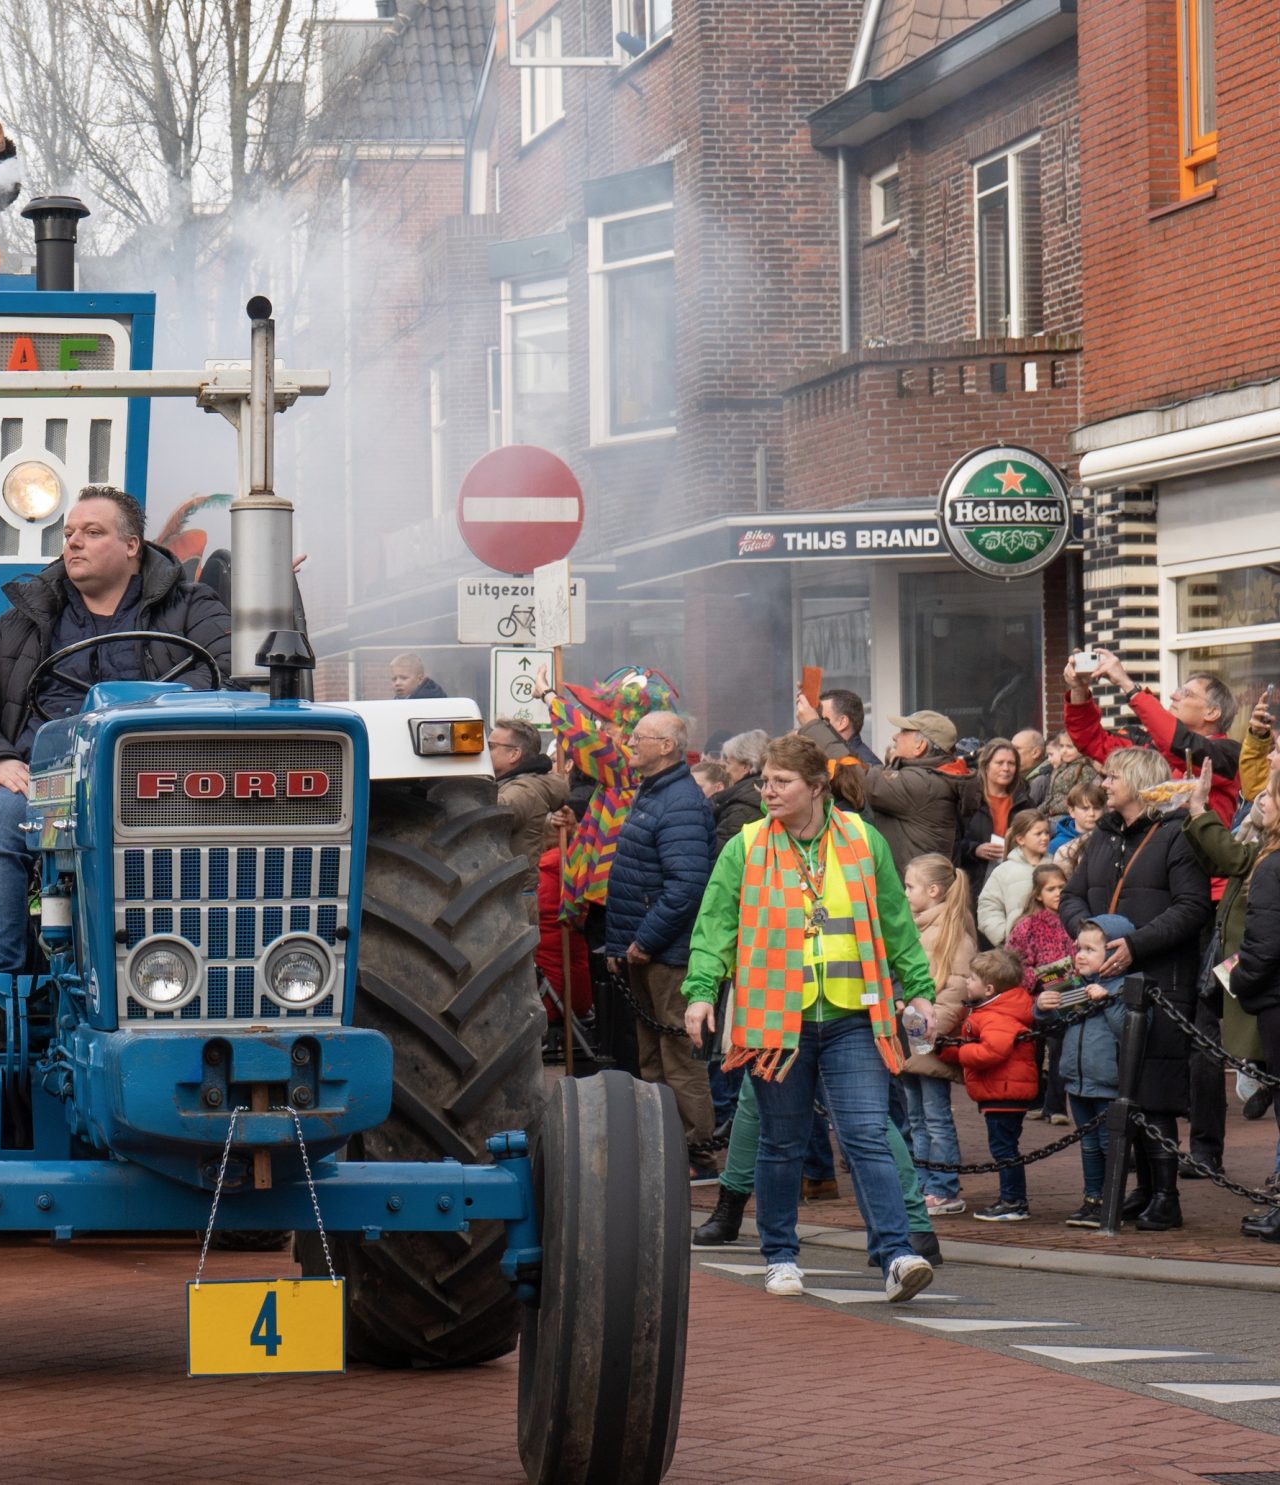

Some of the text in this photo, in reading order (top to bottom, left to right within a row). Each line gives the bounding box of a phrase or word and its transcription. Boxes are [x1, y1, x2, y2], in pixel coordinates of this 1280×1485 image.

[954, 501, 1061, 522] Heineken
[783, 527, 940, 551] THIJS BRAND
[467, 583, 577, 600] uitgezod
[515, 683, 532, 696] 78
[136, 771, 330, 799] FORD
[250, 1291, 282, 1356] 4
